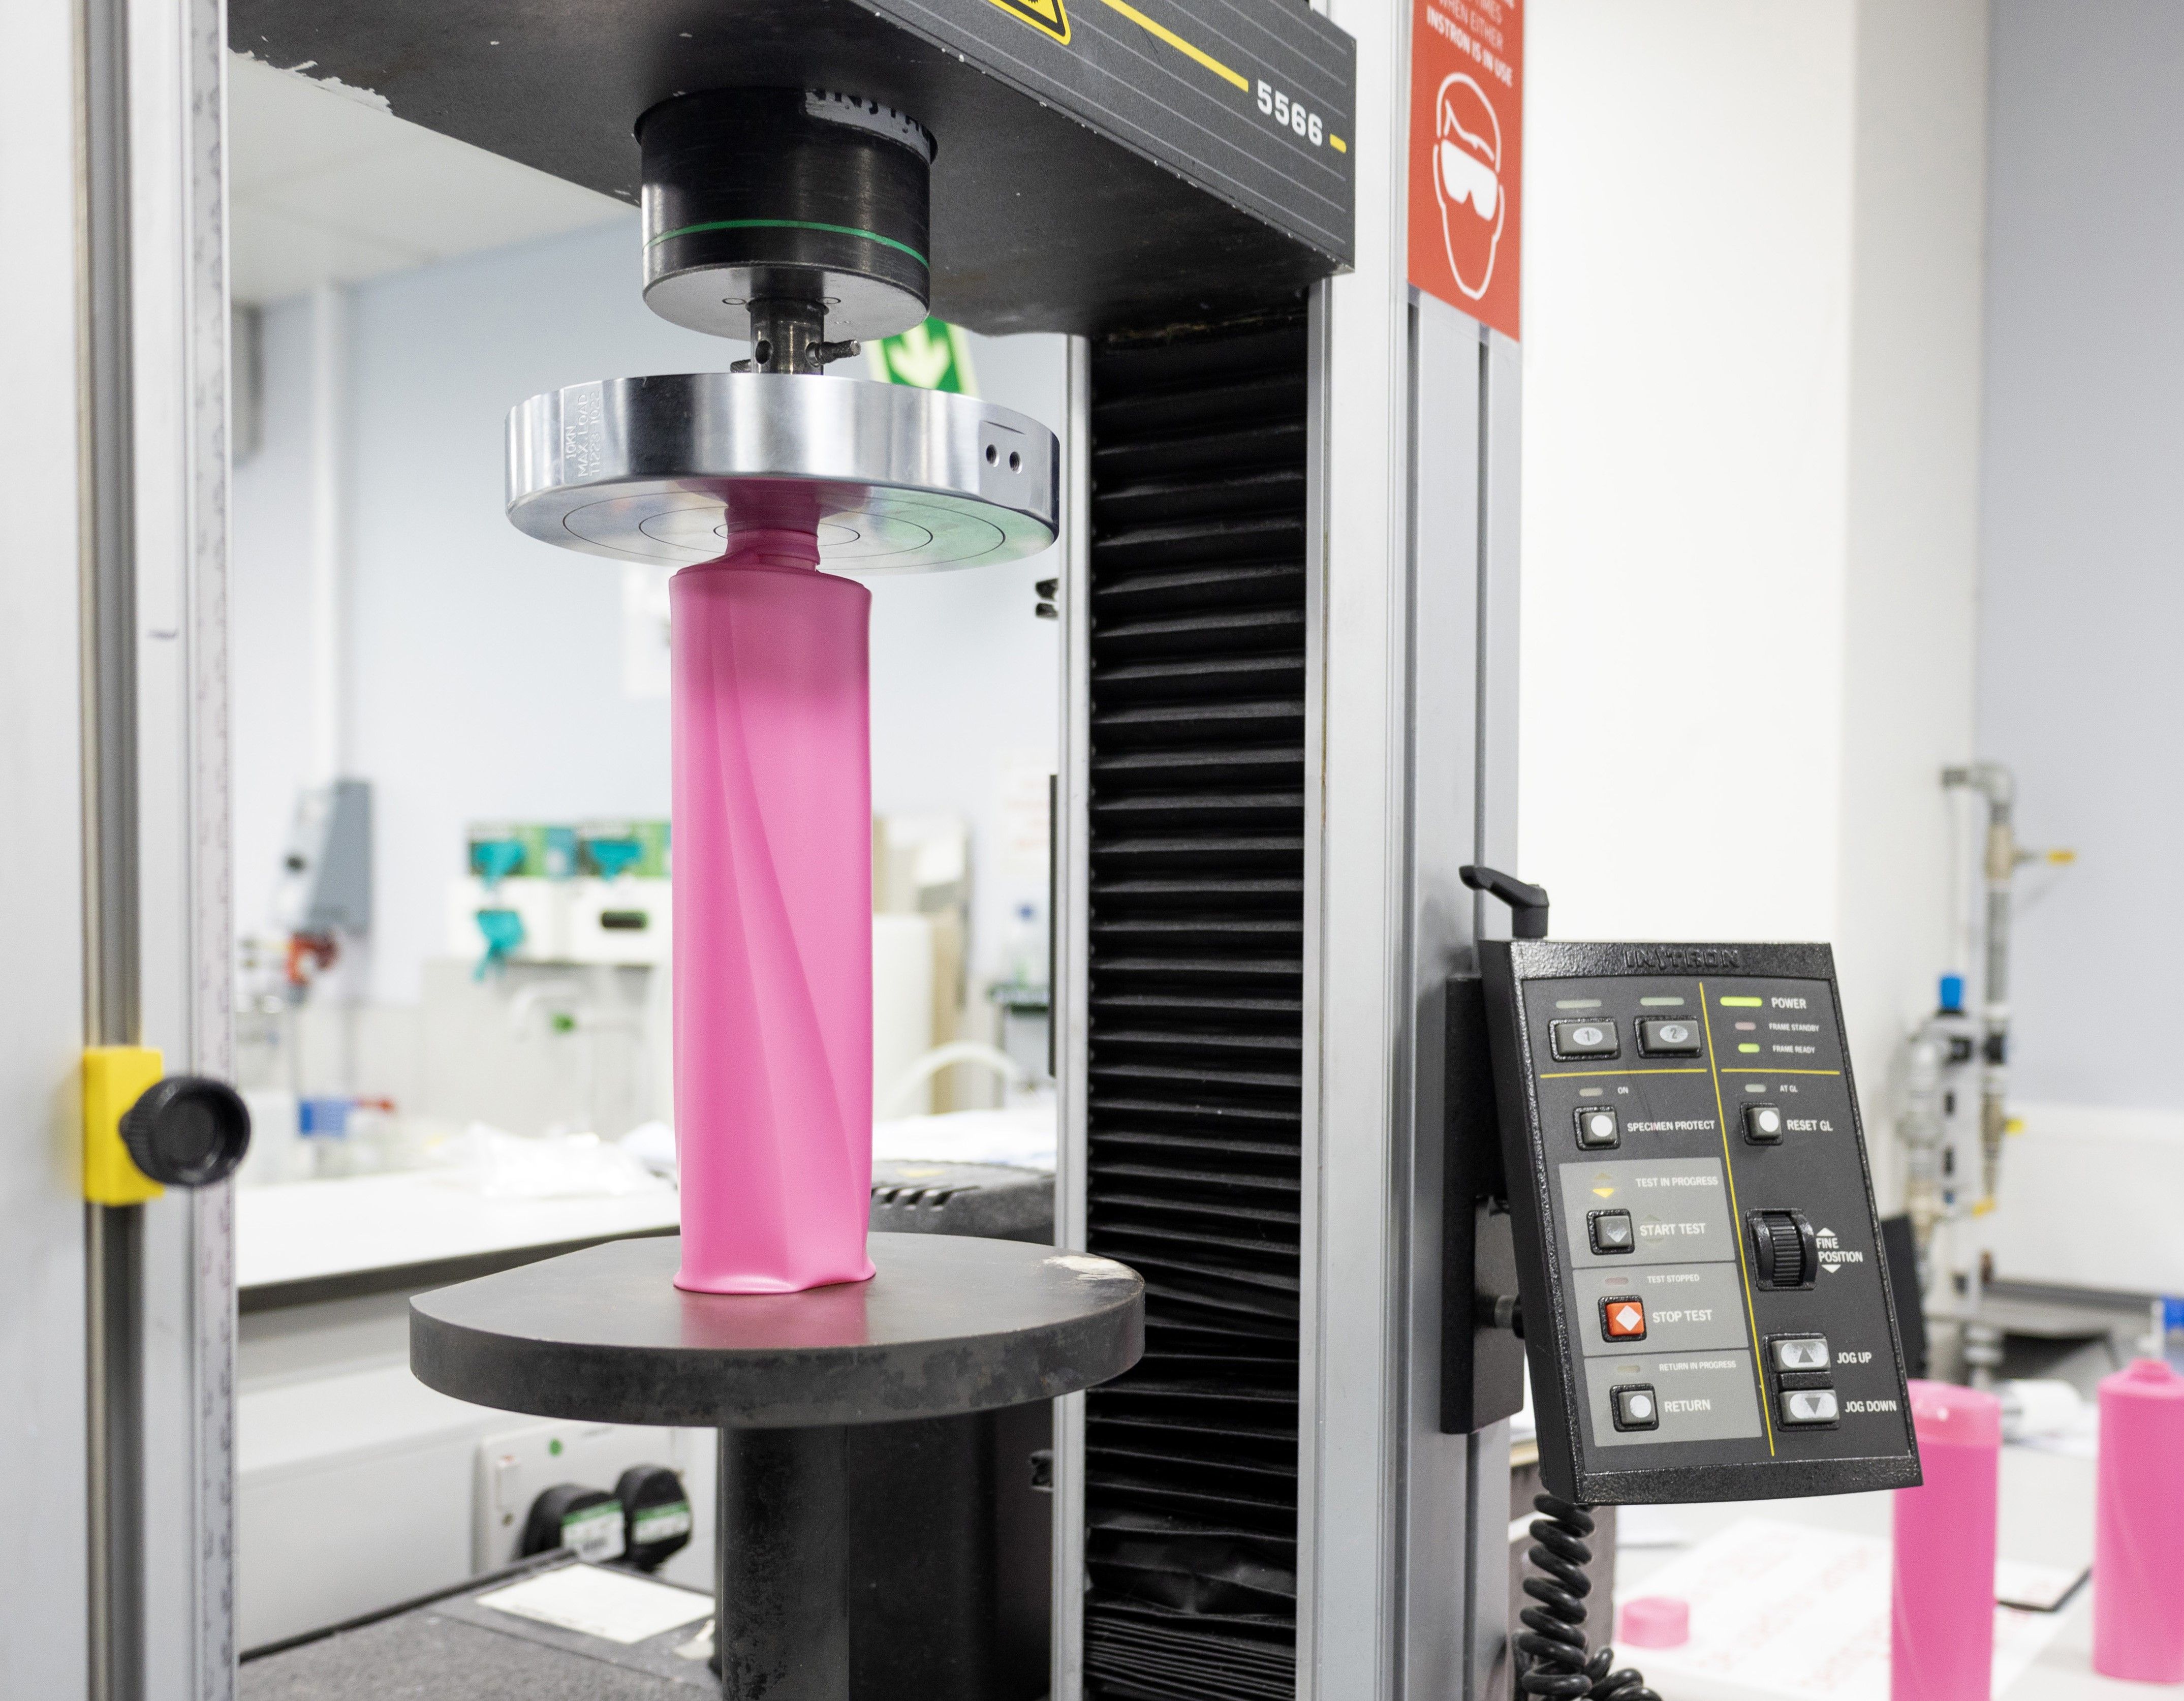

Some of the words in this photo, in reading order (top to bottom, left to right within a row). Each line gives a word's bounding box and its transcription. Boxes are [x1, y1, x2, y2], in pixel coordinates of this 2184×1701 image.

[1470, 10, 1503, 52] EITHER
[1426, 5, 1471, 55] INSTRON
[1471, 40, 1482, 63] IS
[1482, 47, 1493, 72] IN
[1494, 57, 1512, 88] USE
[1257, 79, 1322, 146] 5566
[1771, 997, 1806, 1009] POWER
[1670, 1028, 1677, 1039] 2
[1769, 1023, 1790, 1031] FRAME
[1791, 1023, 1820, 1032] STANDBY
[1585, 1030, 1590, 1041] 1
[1772, 1044, 1794, 1053] FRAME
[1795, 1045, 1815, 1054] READY
[1627, 1121, 1673, 1132] SPECIMEN
[1675, 1120, 1715, 1130] PROTECT
[1786, 1119, 1817, 1131] RESET
[1819, 1120, 1833, 1131] GL
[1635, 1177, 1658, 1187] TEST
[1660, 1177, 1670, 1187] IN
[1671, 1176, 1719, 1186] PROGRESS
[1639, 1223, 1676, 1236] START
[1678, 1222, 1706, 1234] TEST
[1816, 1237, 1839, 1249] FINE
[1818, 1251, 1863, 1262] POSITION
[1647, 1275, 1665, 1284] TEST
[1666, 1274, 1700, 1283] STOPPED
[1652, 1310, 1682, 1323] STOP
[1683, 1309, 1712, 1321] TEST
[1836, 1351, 1857, 1364] JOG
[1858, 1351, 1872, 1364] UP
[1659, 1362, 1689, 1372] RETURN
[1690, 1362, 1698, 1370] IN
[1699, 1359, 1736, 1370] PROGRESS
[1664, 1399, 1711, 1413] RETURN
[1845, 1401, 1865, 1413] JOG
[1866, 1400, 1897, 1412] DOWN
